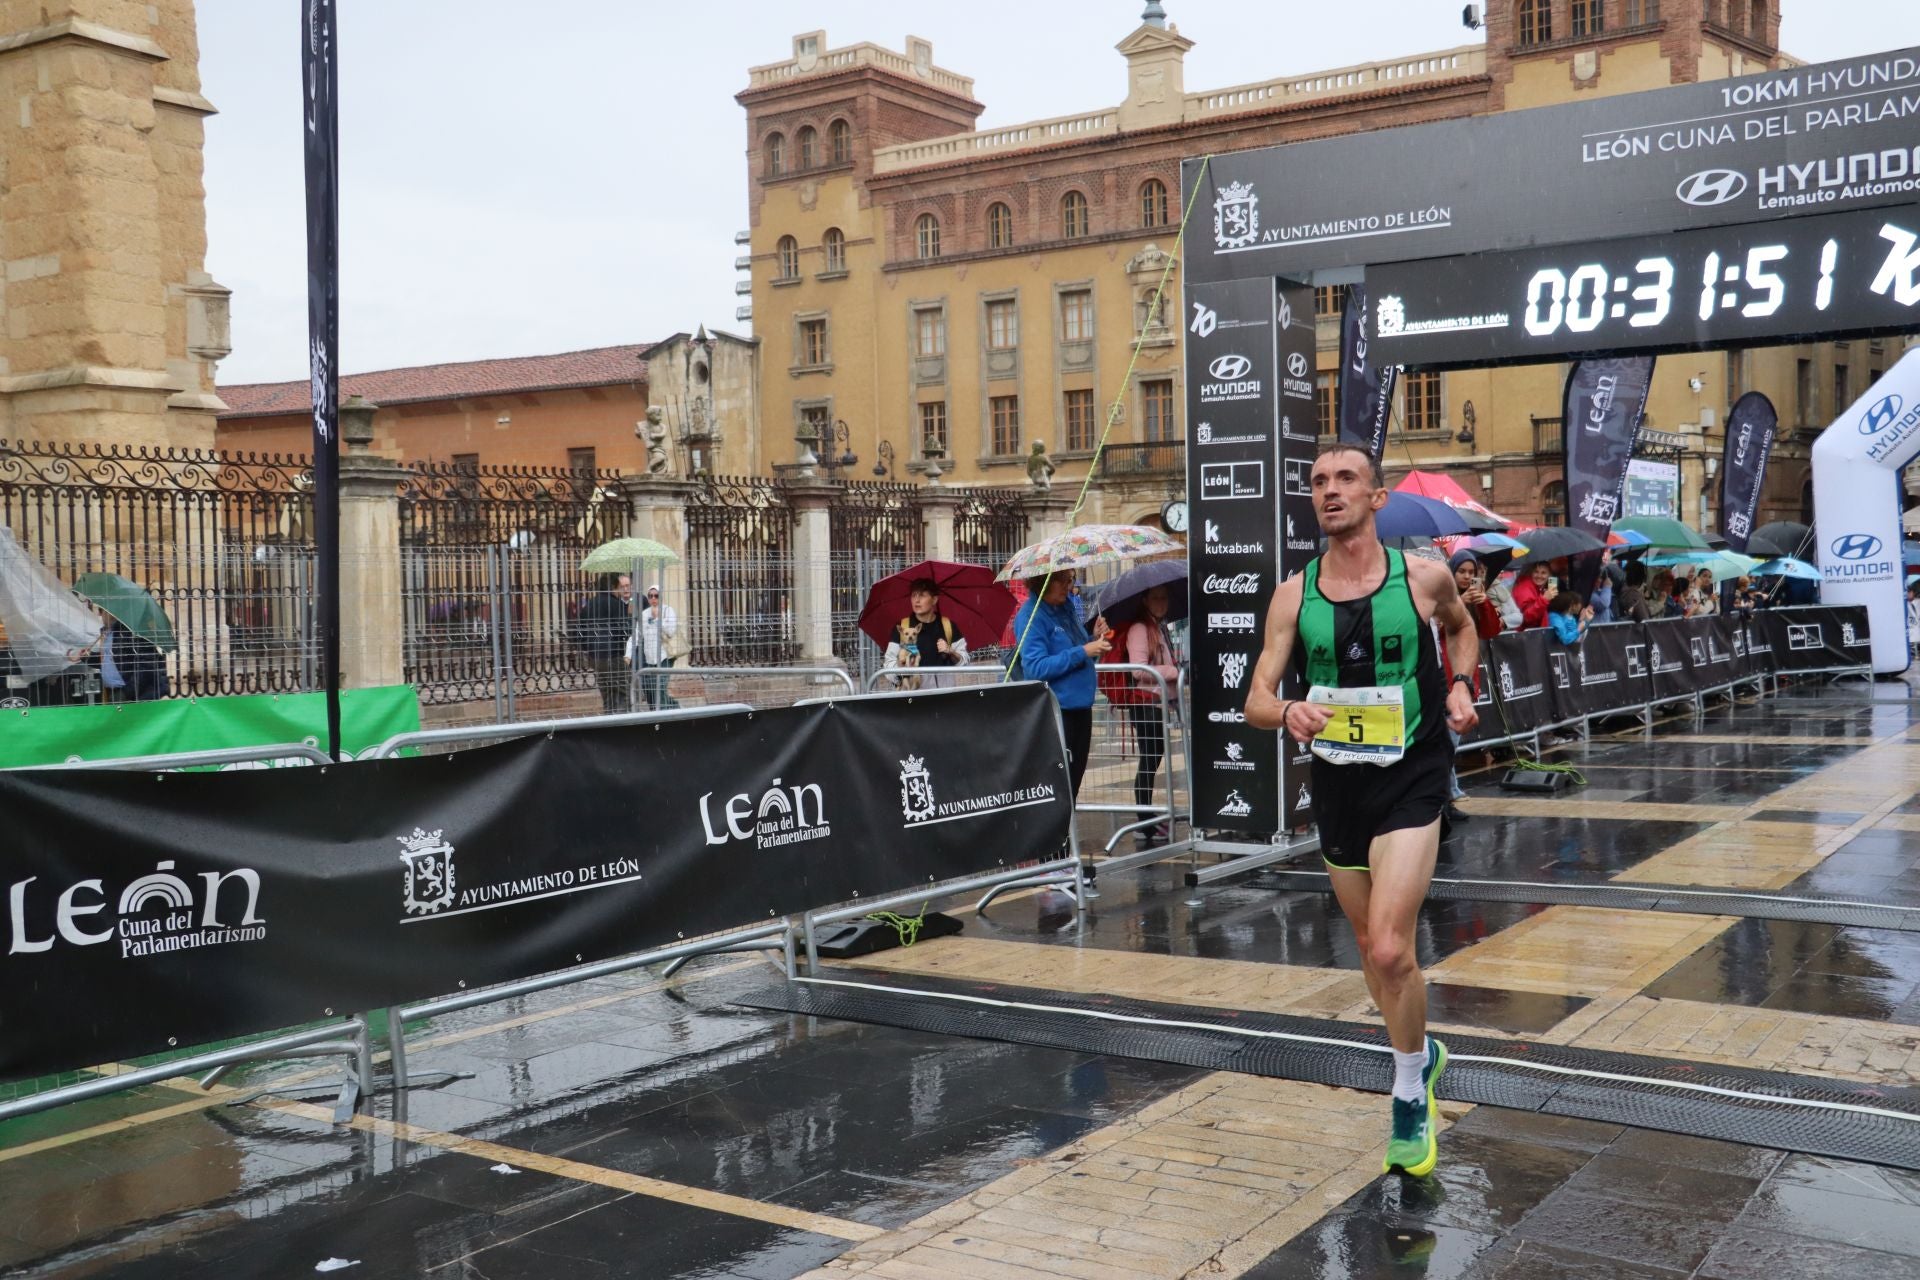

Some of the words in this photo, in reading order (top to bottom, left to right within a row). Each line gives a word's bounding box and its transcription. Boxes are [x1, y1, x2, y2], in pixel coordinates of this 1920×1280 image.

[1721, 78, 1798, 107] 10KM
[1582, 134, 1650, 162] LEÓN
[1658, 124, 1736, 151] CUNA
[1745, 115, 1796, 140] DEL
[1759, 145, 1920, 195] HYUND
[1759, 189, 1835, 209] Lemauto
[1262, 216, 1379, 242] AYUNTAMIENTO
[1385, 213, 1404, 227] DE
[1410, 205, 1451, 224] LEÓN
[1524, 238, 1838, 337] 00:31:51
[1405, 317, 1470, 331] AYUNTAMIENTO
[1471, 315, 1483, 325] DE
[1485, 312, 1509, 324] LEÓN
[1201, 381, 1260, 396] HYUNDAI
[1284, 378, 1311, 394] HYUNDAI
[1201, 394, 1225, 402] Lemauto
[1226, 392, 1260, 401] Automoción
[1205, 474, 1229, 486] LEÓN
[1205, 541, 1263, 554] kutxabank
[1287, 538, 1315, 550] kutxabank
[1825, 561, 1893, 576] HYUNDAI
[1218, 653, 1247, 667] KAM
[1223, 676, 1243, 688] NY
[1348, 715, 1363, 743] 5
[1344, 753, 1387, 763] HYUNDAI
[938, 792, 1012, 815] AYUNTAMIENTO
[1014, 789, 1025, 801] DE
[1026, 783, 1054, 799] LEÓN
[757, 820, 779, 835] Cuna
[780, 815, 794, 829] del
[757, 825, 831, 850] Parlamentarismo
[459, 870, 574, 906] AYUNTAMIENTO
[578, 865, 597, 883] DE
[601, 856, 640, 878] LEÓN
[118, 916, 162, 938] Cuna
[166, 911, 193, 930] del
[120, 925, 266, 958] Parlamentarismo
